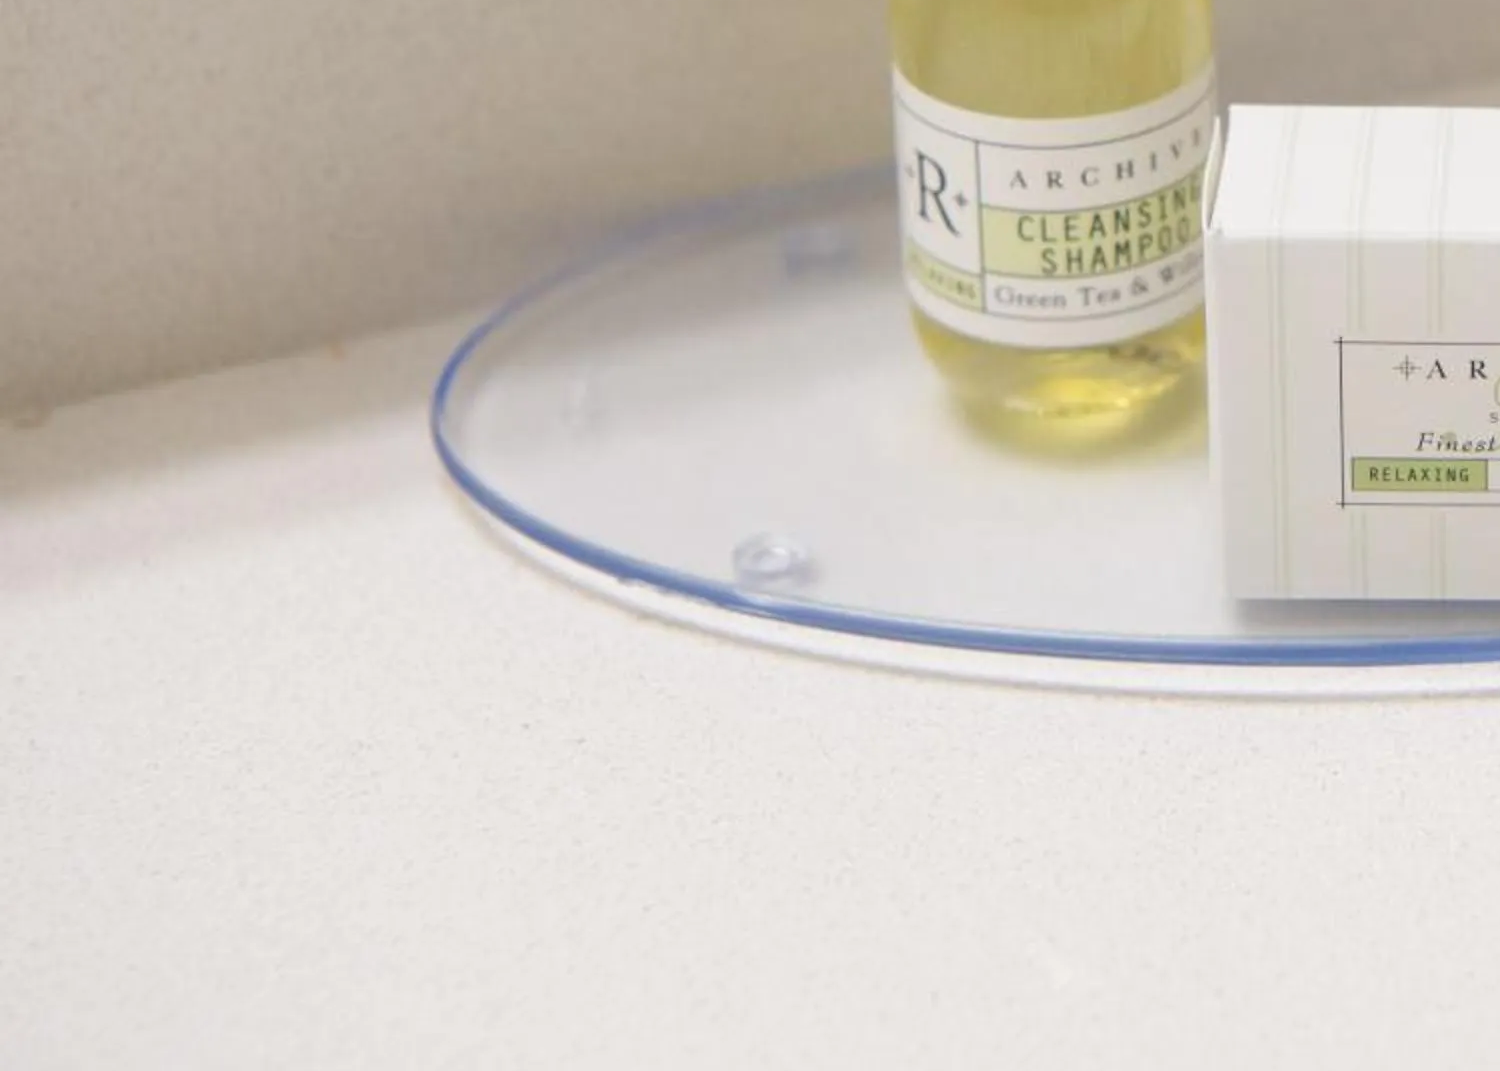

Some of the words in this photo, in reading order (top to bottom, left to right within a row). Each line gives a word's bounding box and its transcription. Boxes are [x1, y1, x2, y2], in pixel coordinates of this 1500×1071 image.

[915, 148, 961, 238] R
[1040, 216, 1192, 276] SHAMPOO
[994, 284, 1068, 308] Green
[1416, 432, 1497, 453] Finest
[1368, 466, 1470, 482] RELAXING
